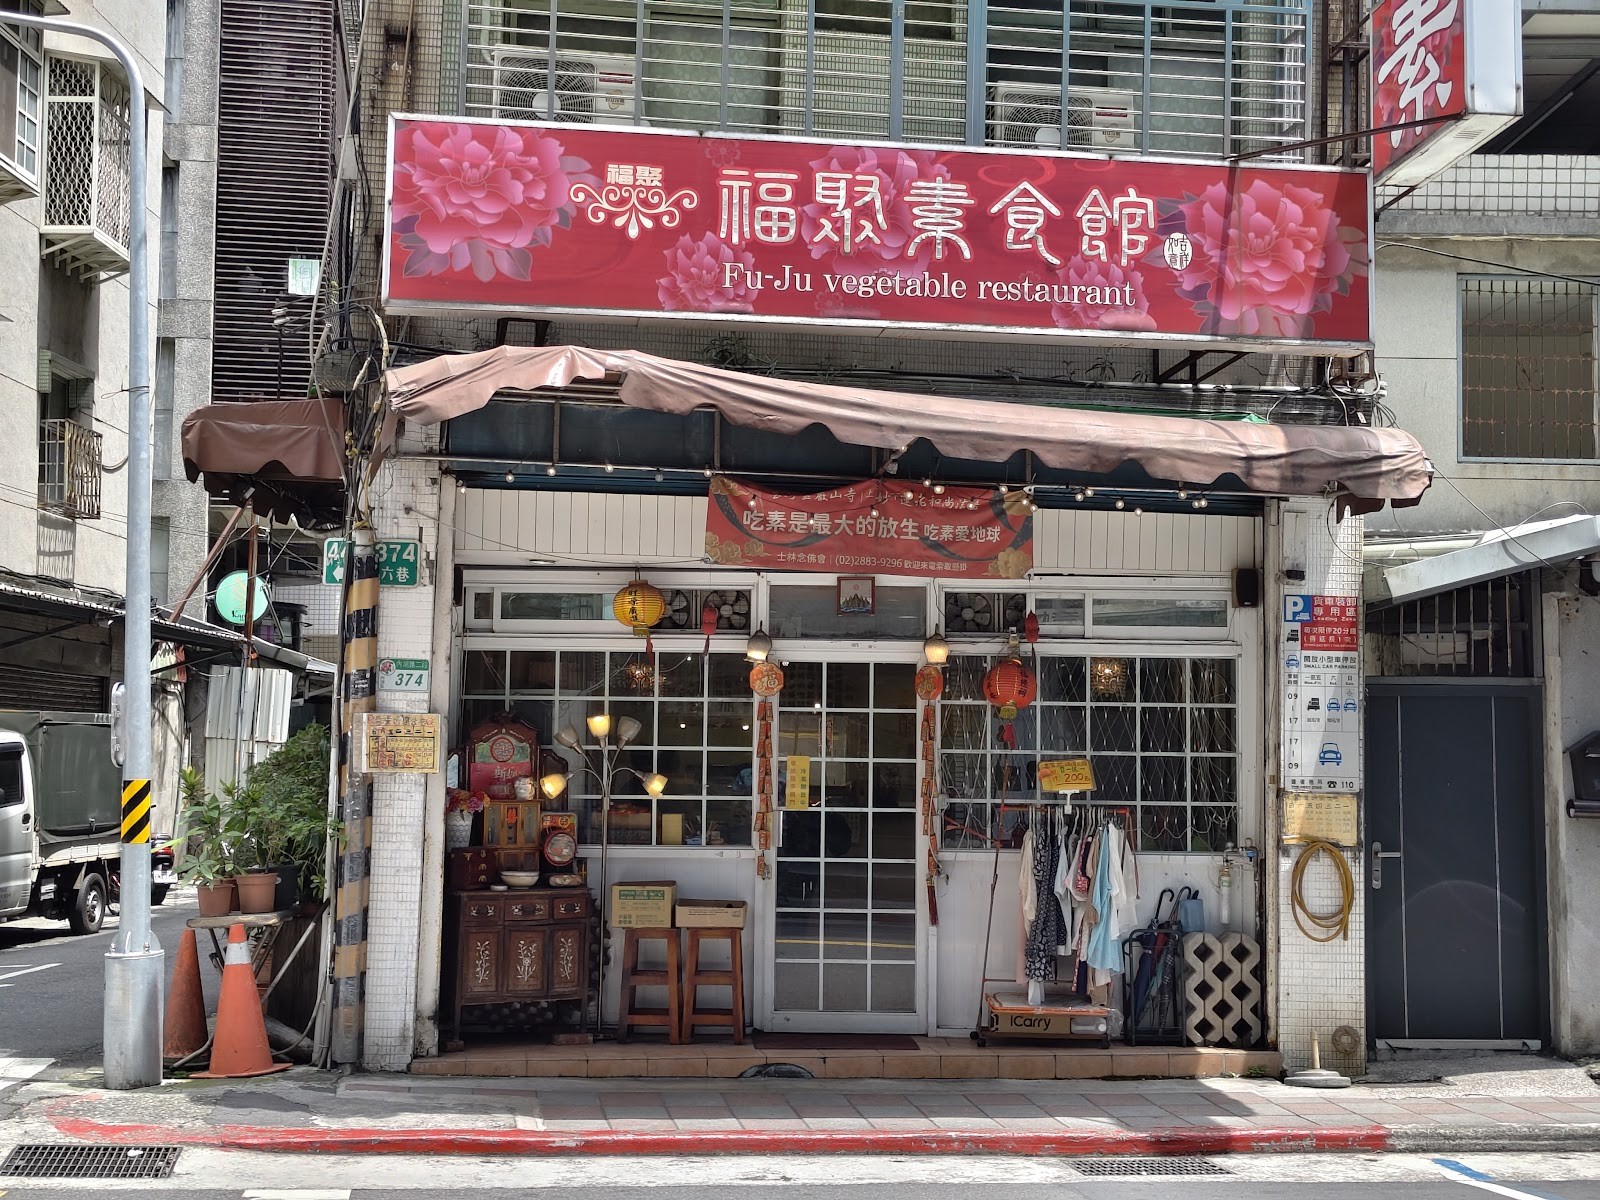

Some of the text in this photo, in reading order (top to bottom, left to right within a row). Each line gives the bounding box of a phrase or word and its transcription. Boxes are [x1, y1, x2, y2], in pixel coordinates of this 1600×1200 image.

[606, 163, 663, 188] 福聚
[718, 168, 1156, 267] 福聚素食館
[722, 261, 1136, 307] Fu-Ju vegetable restaurant
[743, 510, 1001, 544] 吃素是最大的放生 吃素愛地球
[835, 554, 903, 568] (02)2883-9296
[1286, 596, 1304, 621] P
[395, 673, 424, 687] 374
[1287, 692, 1299, 700] 09
[1287, 762, 1299, 770] 09
[1341, 781, 1354, 789] 110
